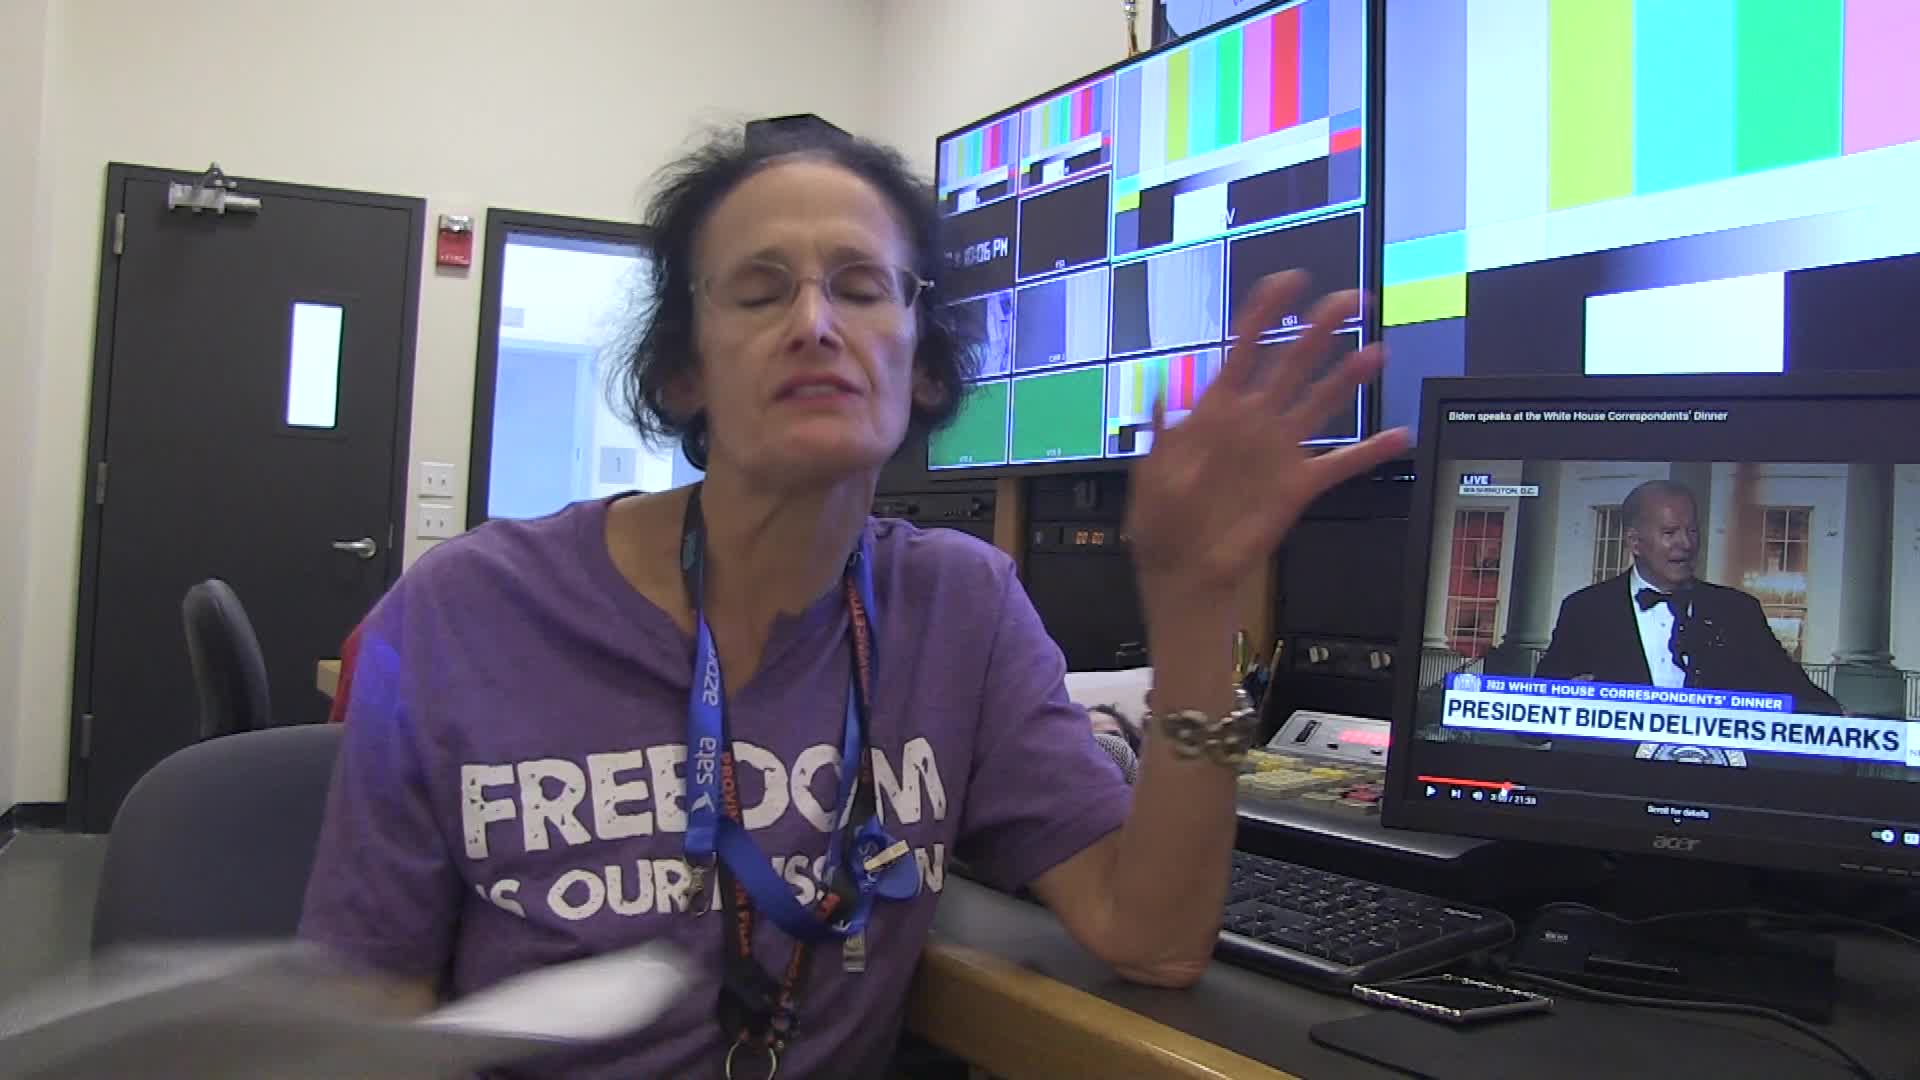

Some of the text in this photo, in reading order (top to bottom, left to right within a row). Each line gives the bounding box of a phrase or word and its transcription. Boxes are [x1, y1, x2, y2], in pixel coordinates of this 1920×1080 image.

[993, 237, 1009, 258] PM
[1448, 410, 1729, 423] Biden speaks at the White House Correspondents' Dinner
[1463, 475, 1489, 485] LIVE
[1508, 681, 1548, 694] WHITE
[1551, 684, 1596, 697] HOUSE
[1599, 687, 1727, 706] CORRESPONDENTS'
[1730, 695, 1783, 711] DINNER
[1447, 699, 1900, 751] PRESIDENT BIDEN DELIVERS REMARKS
[696, 737, 717, 785] sata
[1652, 836, 1702, 851] acer
[547, 858, 692, 921] OUR
